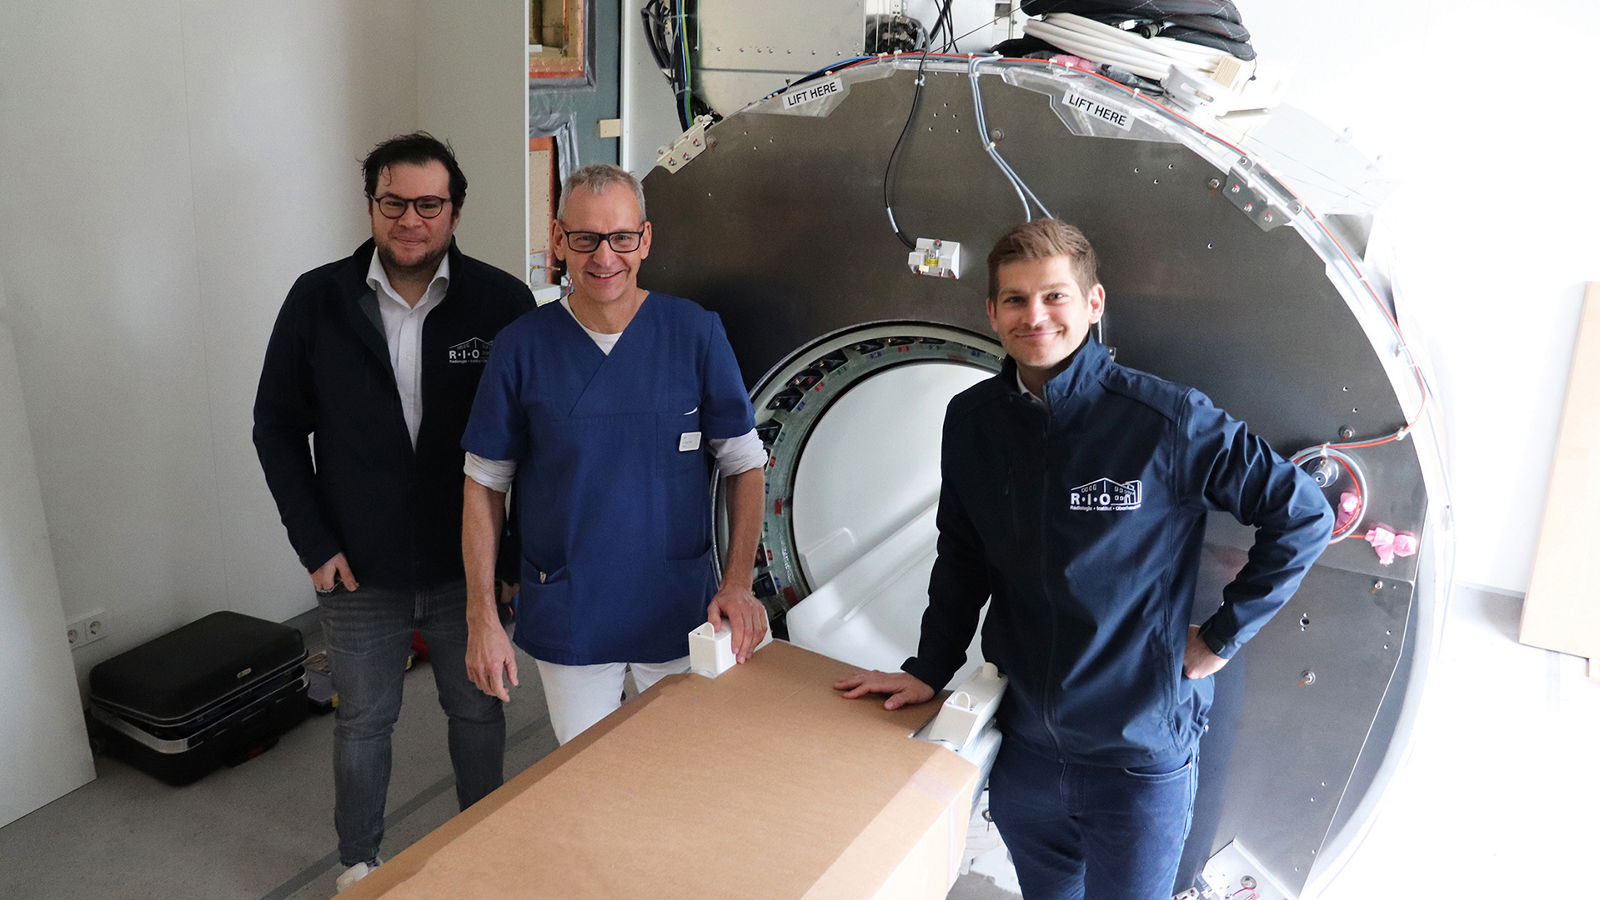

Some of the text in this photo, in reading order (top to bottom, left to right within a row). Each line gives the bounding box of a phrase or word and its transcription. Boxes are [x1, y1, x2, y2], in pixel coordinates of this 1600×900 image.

[787, 81, 838, 106] LIFT HERE
[1069, 94, 1128, 126] LIFT HERE
